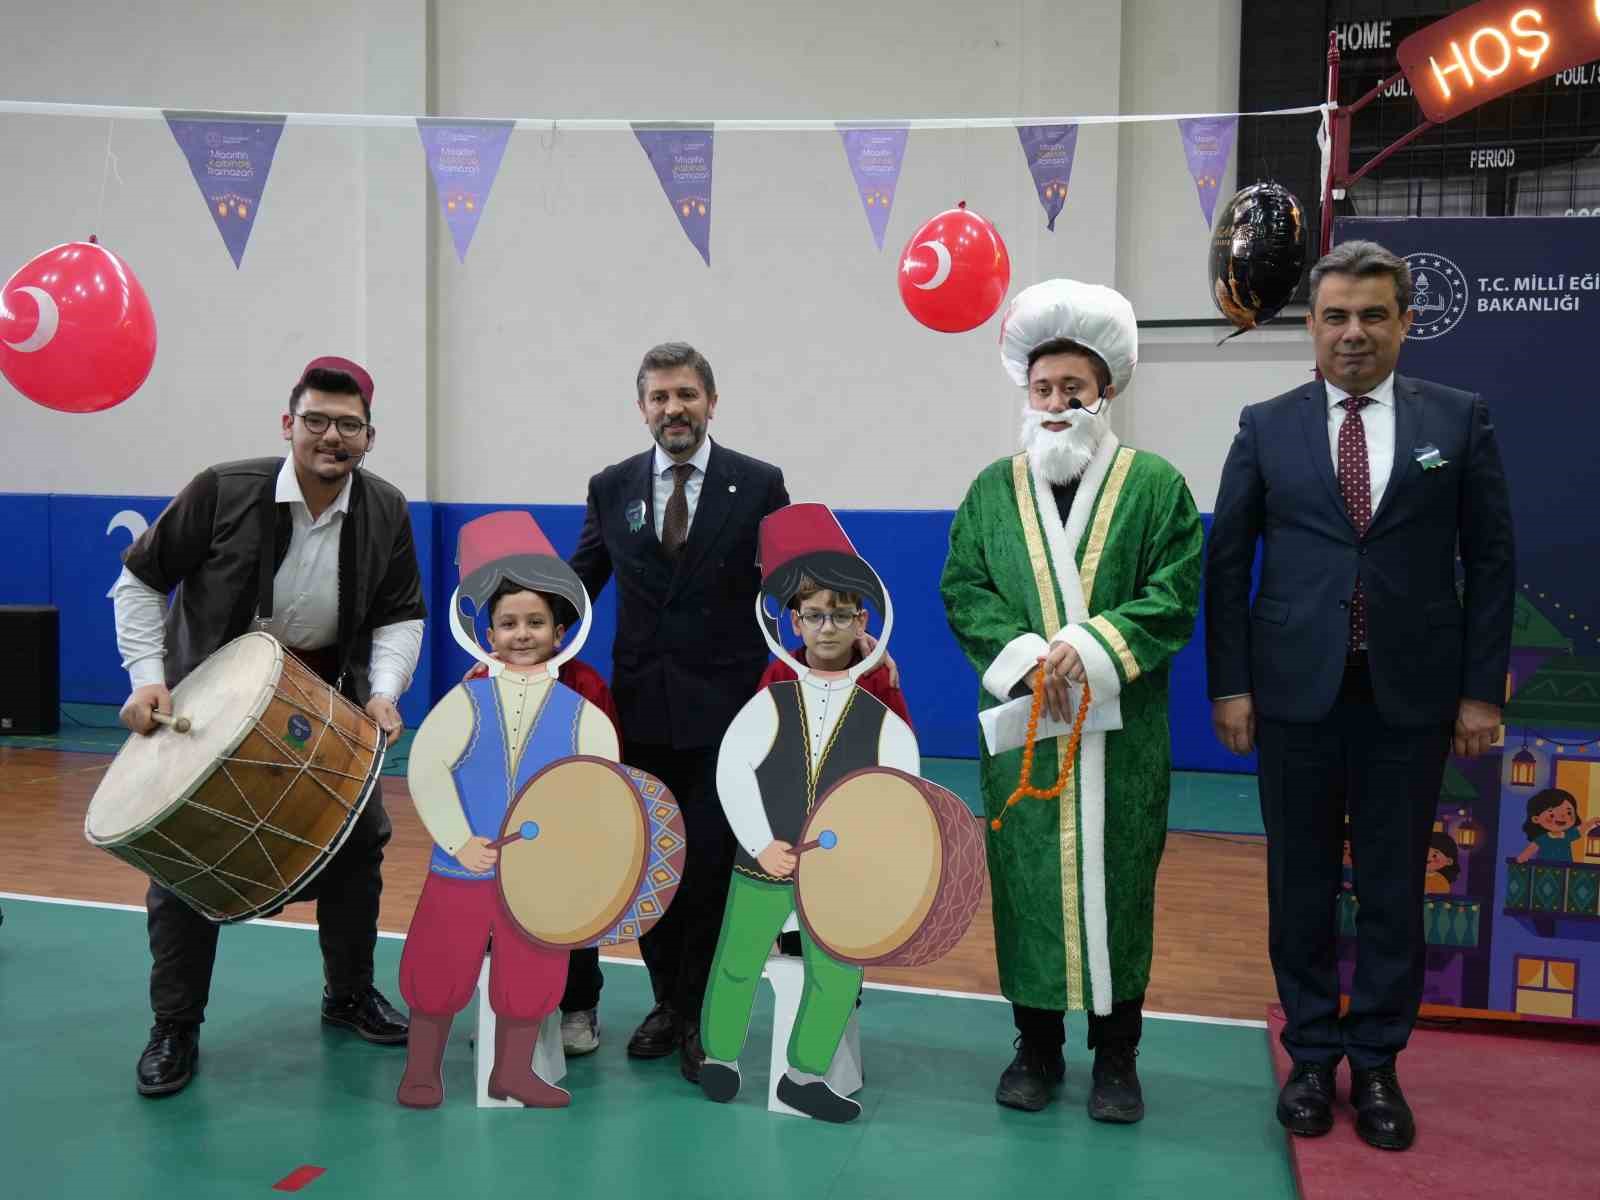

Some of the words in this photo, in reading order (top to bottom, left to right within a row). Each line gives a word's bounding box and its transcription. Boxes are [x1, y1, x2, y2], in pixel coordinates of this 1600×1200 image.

[1335, 20, 1392, 50] HOME
[1428, 8, 1551, 99] HOŞ
[1470, 149, 1515, 169] PERIOD
[1477, 278, 1509, 292] T.C.
[1514, 274, 1564, 291] MİLLÎ
[1477, 294, 1579, 312] BAKANLIĞI
